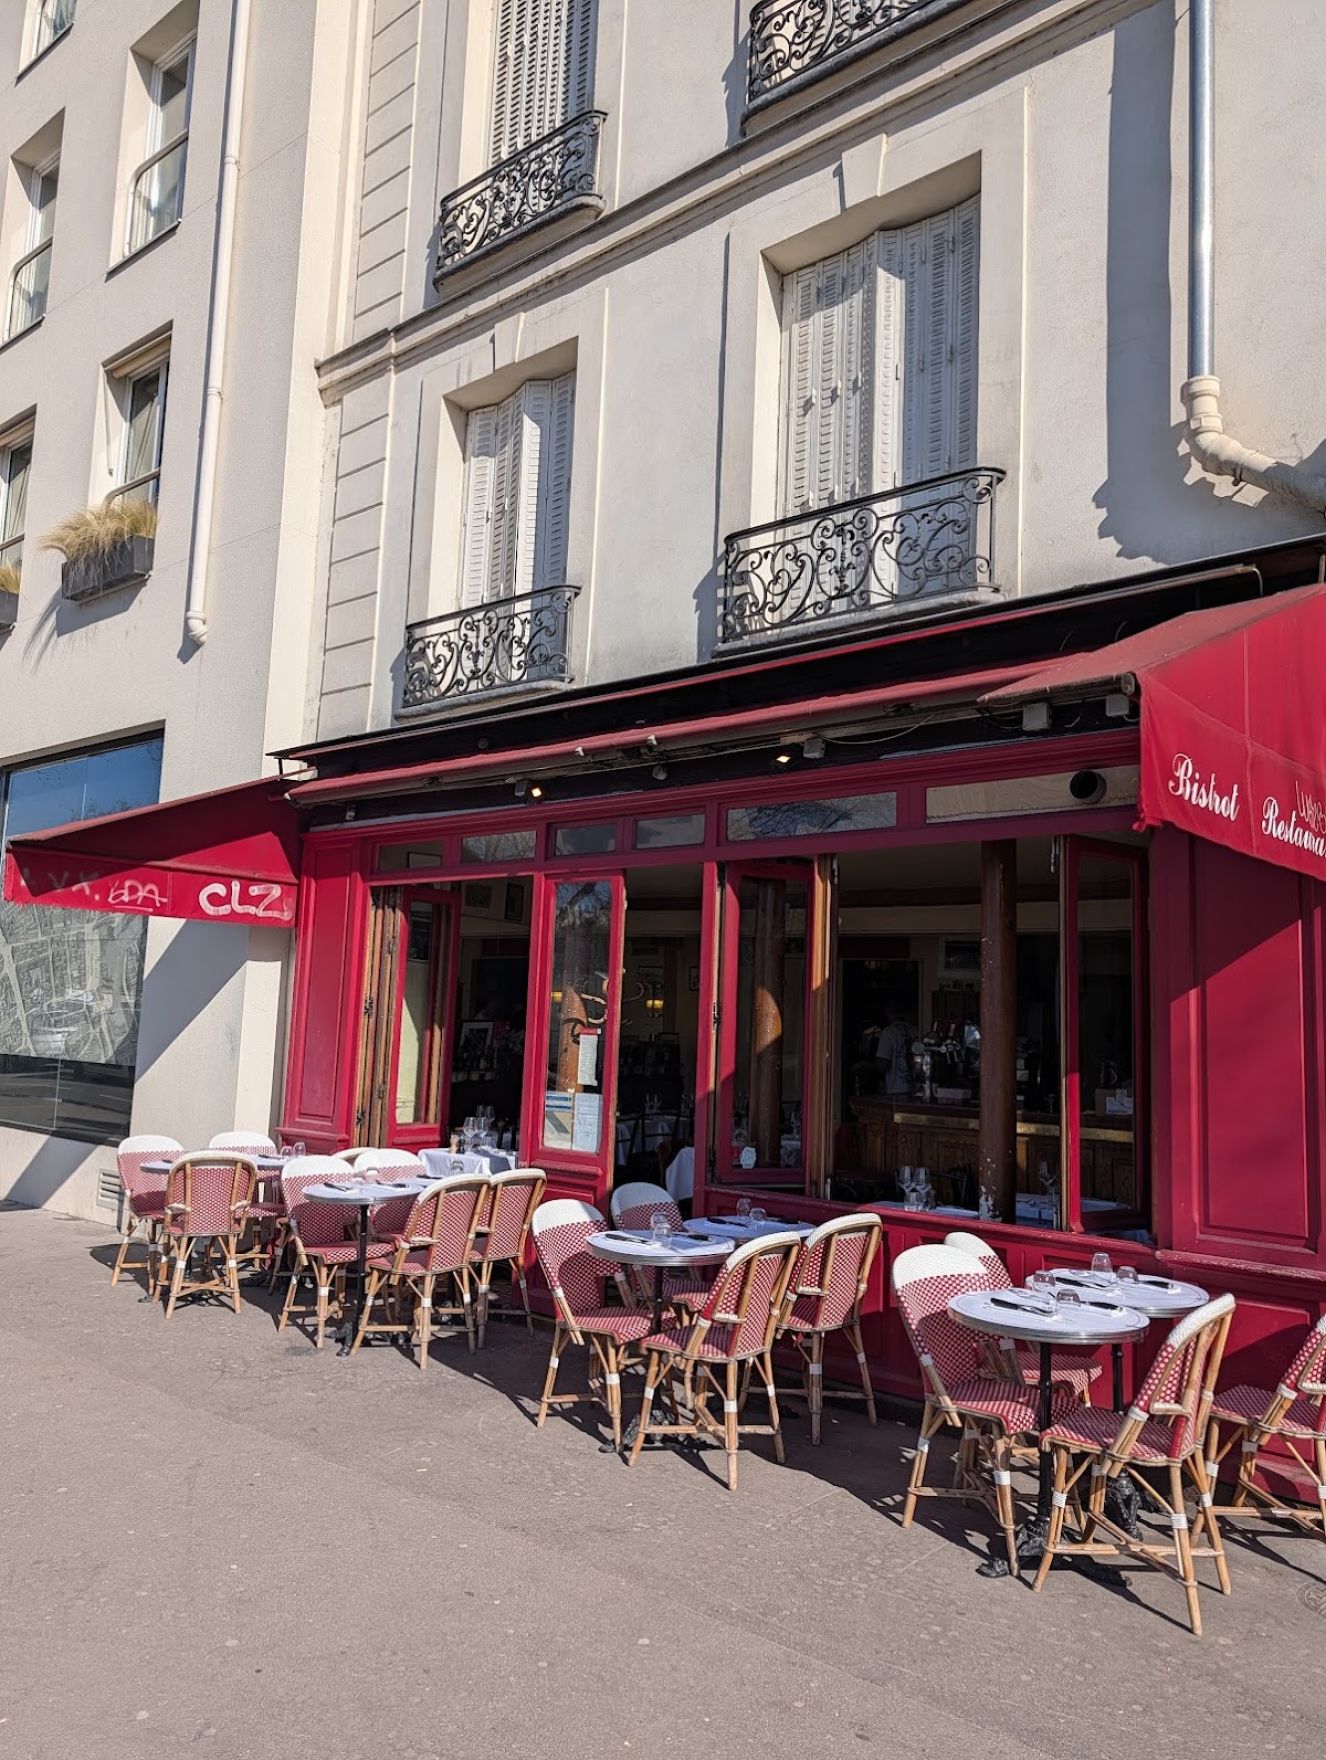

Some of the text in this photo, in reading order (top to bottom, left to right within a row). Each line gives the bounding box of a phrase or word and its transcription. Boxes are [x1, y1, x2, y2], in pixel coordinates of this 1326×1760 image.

[1169, 754, 1240, 820] Bistrot
[1262, 797, 1326, 857] Restaura
[199, 880, 293, 920] CLZ
